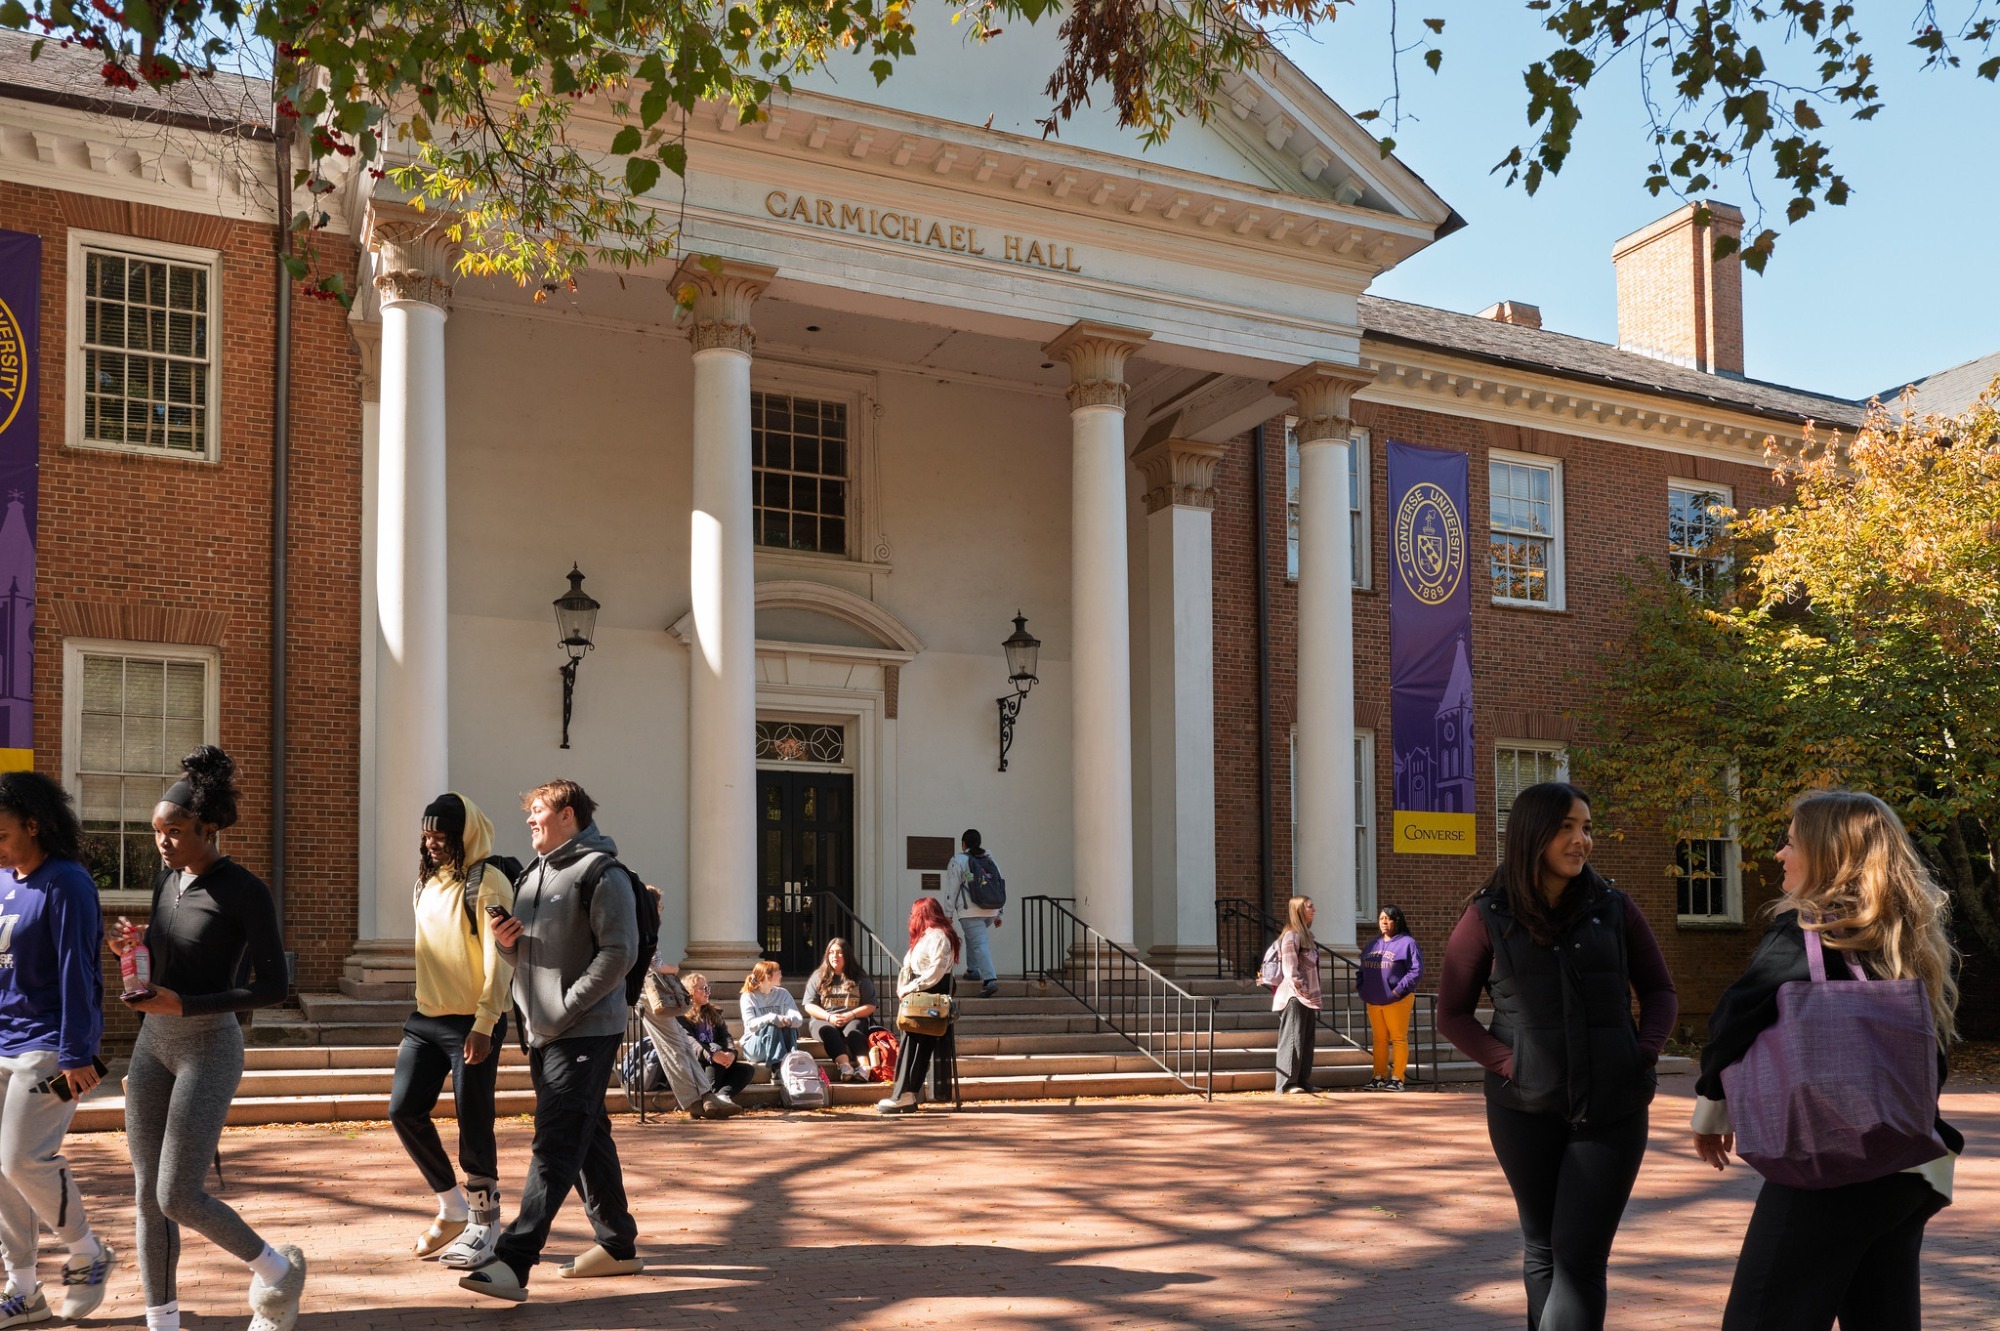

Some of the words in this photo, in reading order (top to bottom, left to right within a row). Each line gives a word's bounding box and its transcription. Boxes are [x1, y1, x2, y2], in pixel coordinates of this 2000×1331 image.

[766, 190, 984, 255] CARMICHAEL
[1004, 234, 1081, 273] HALL
[1400, 489, 1424, 563] CONVERSE
[1430, 489, 1460, 570] UNIVERSITY
[1417, 584, 1444, 599] 1889
